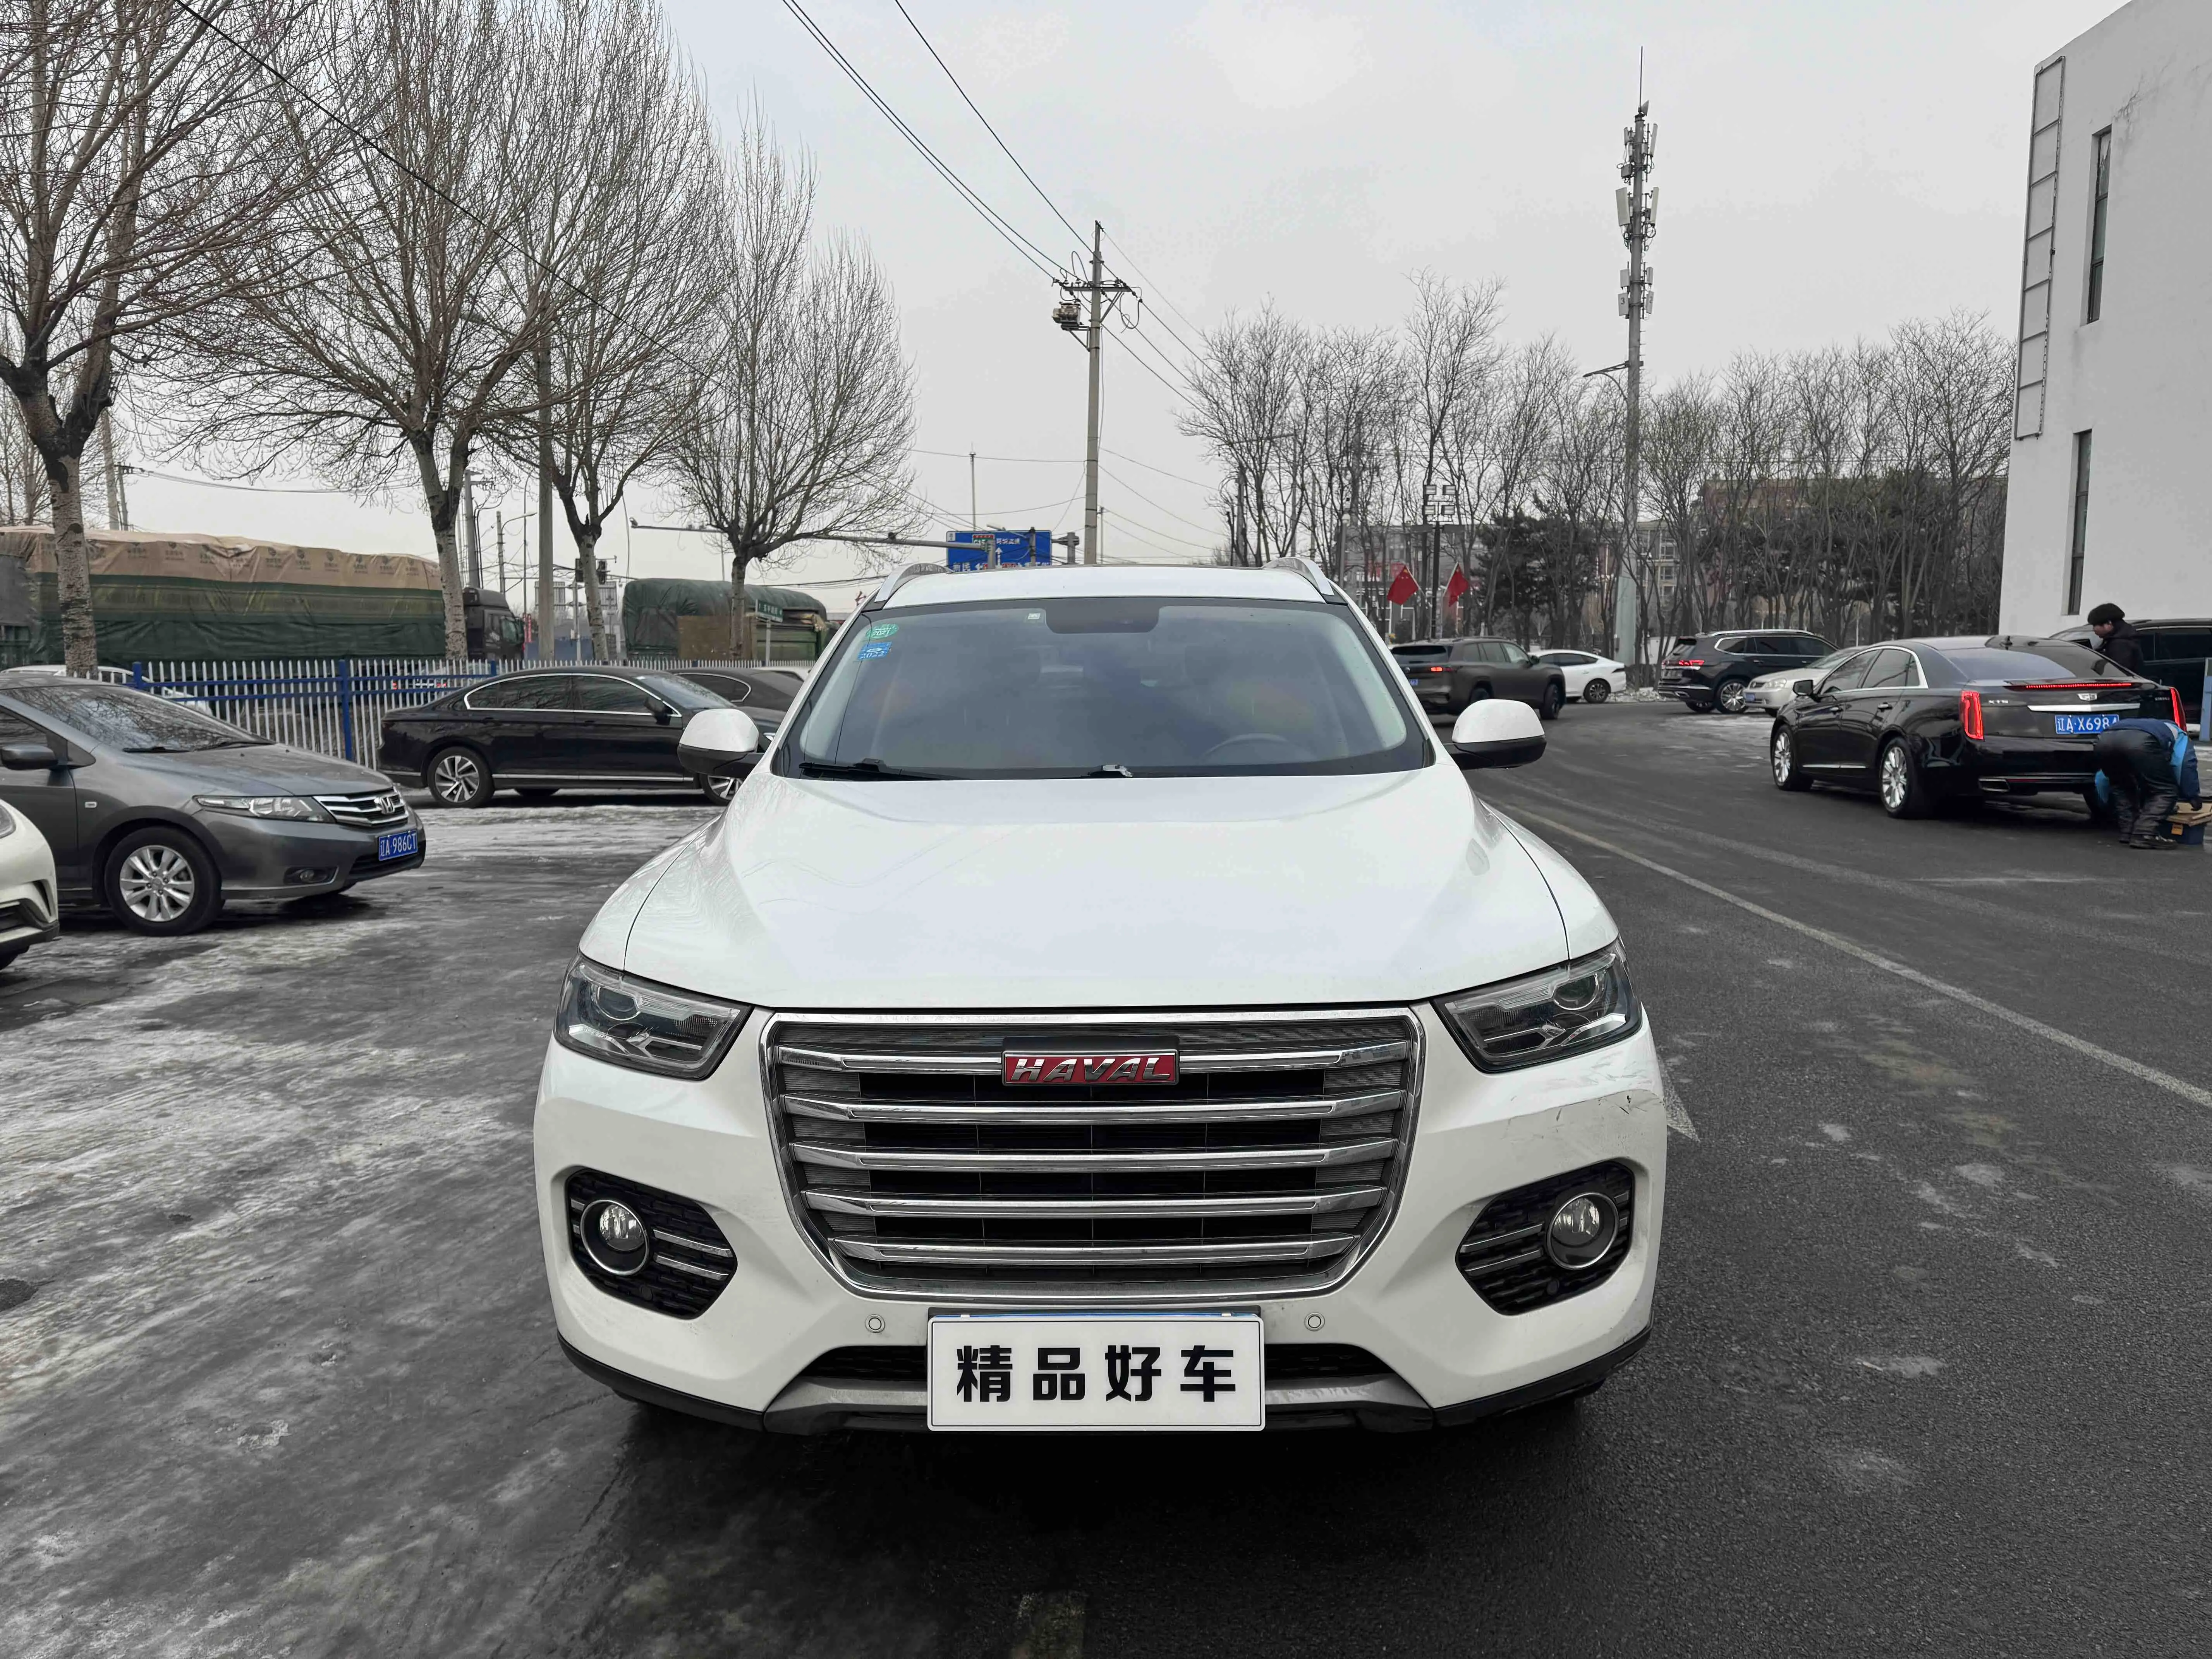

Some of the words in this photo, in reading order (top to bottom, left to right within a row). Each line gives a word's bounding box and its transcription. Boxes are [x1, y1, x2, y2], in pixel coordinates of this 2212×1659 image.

[1011, 1057, 1170, 1082] HAVAL
[957, 1345, 1236, 1402] 精品好车
